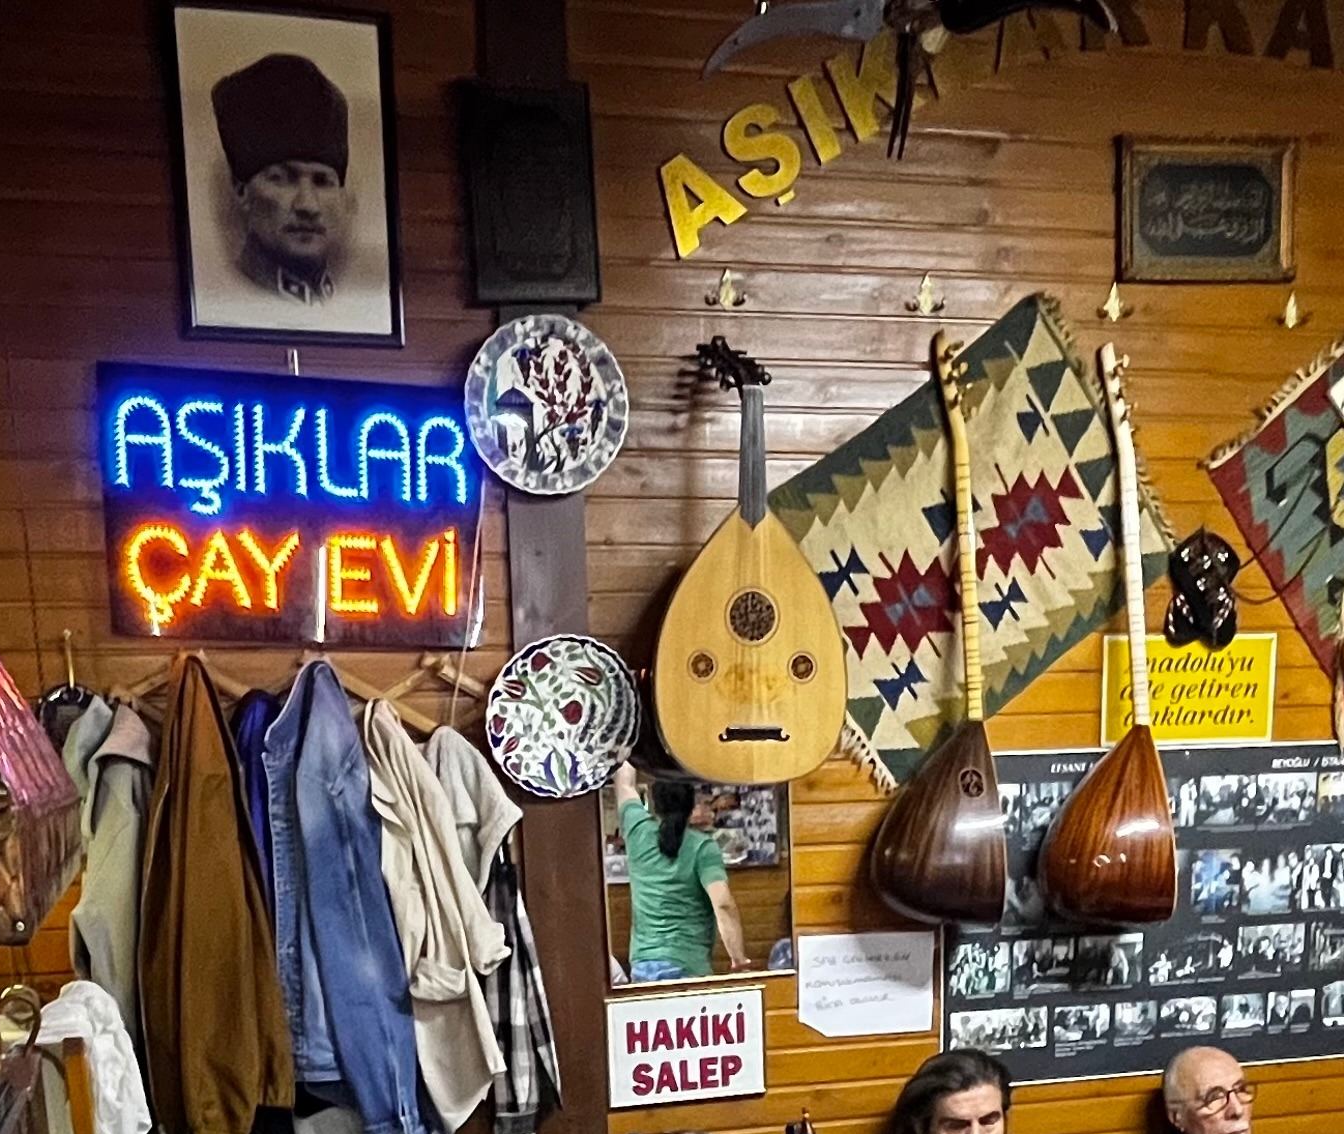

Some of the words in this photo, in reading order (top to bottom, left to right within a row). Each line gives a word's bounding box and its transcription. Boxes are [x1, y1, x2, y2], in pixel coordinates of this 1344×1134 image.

[113, 395, 467, 516] AŞIKLAR
[126, 524, 302, 626] ÇAY
[325, 525, 458, 617] EVİ
[1123, 651, 1255, 678] nadolu'yu
[1169, 678, 1259, 705] getiren
[1123, 704, 1255, 728] aıklardır.
[625, 1002, 746, 1055] HAKİKİ
[631, 1054, 743, 1096] SALEP
